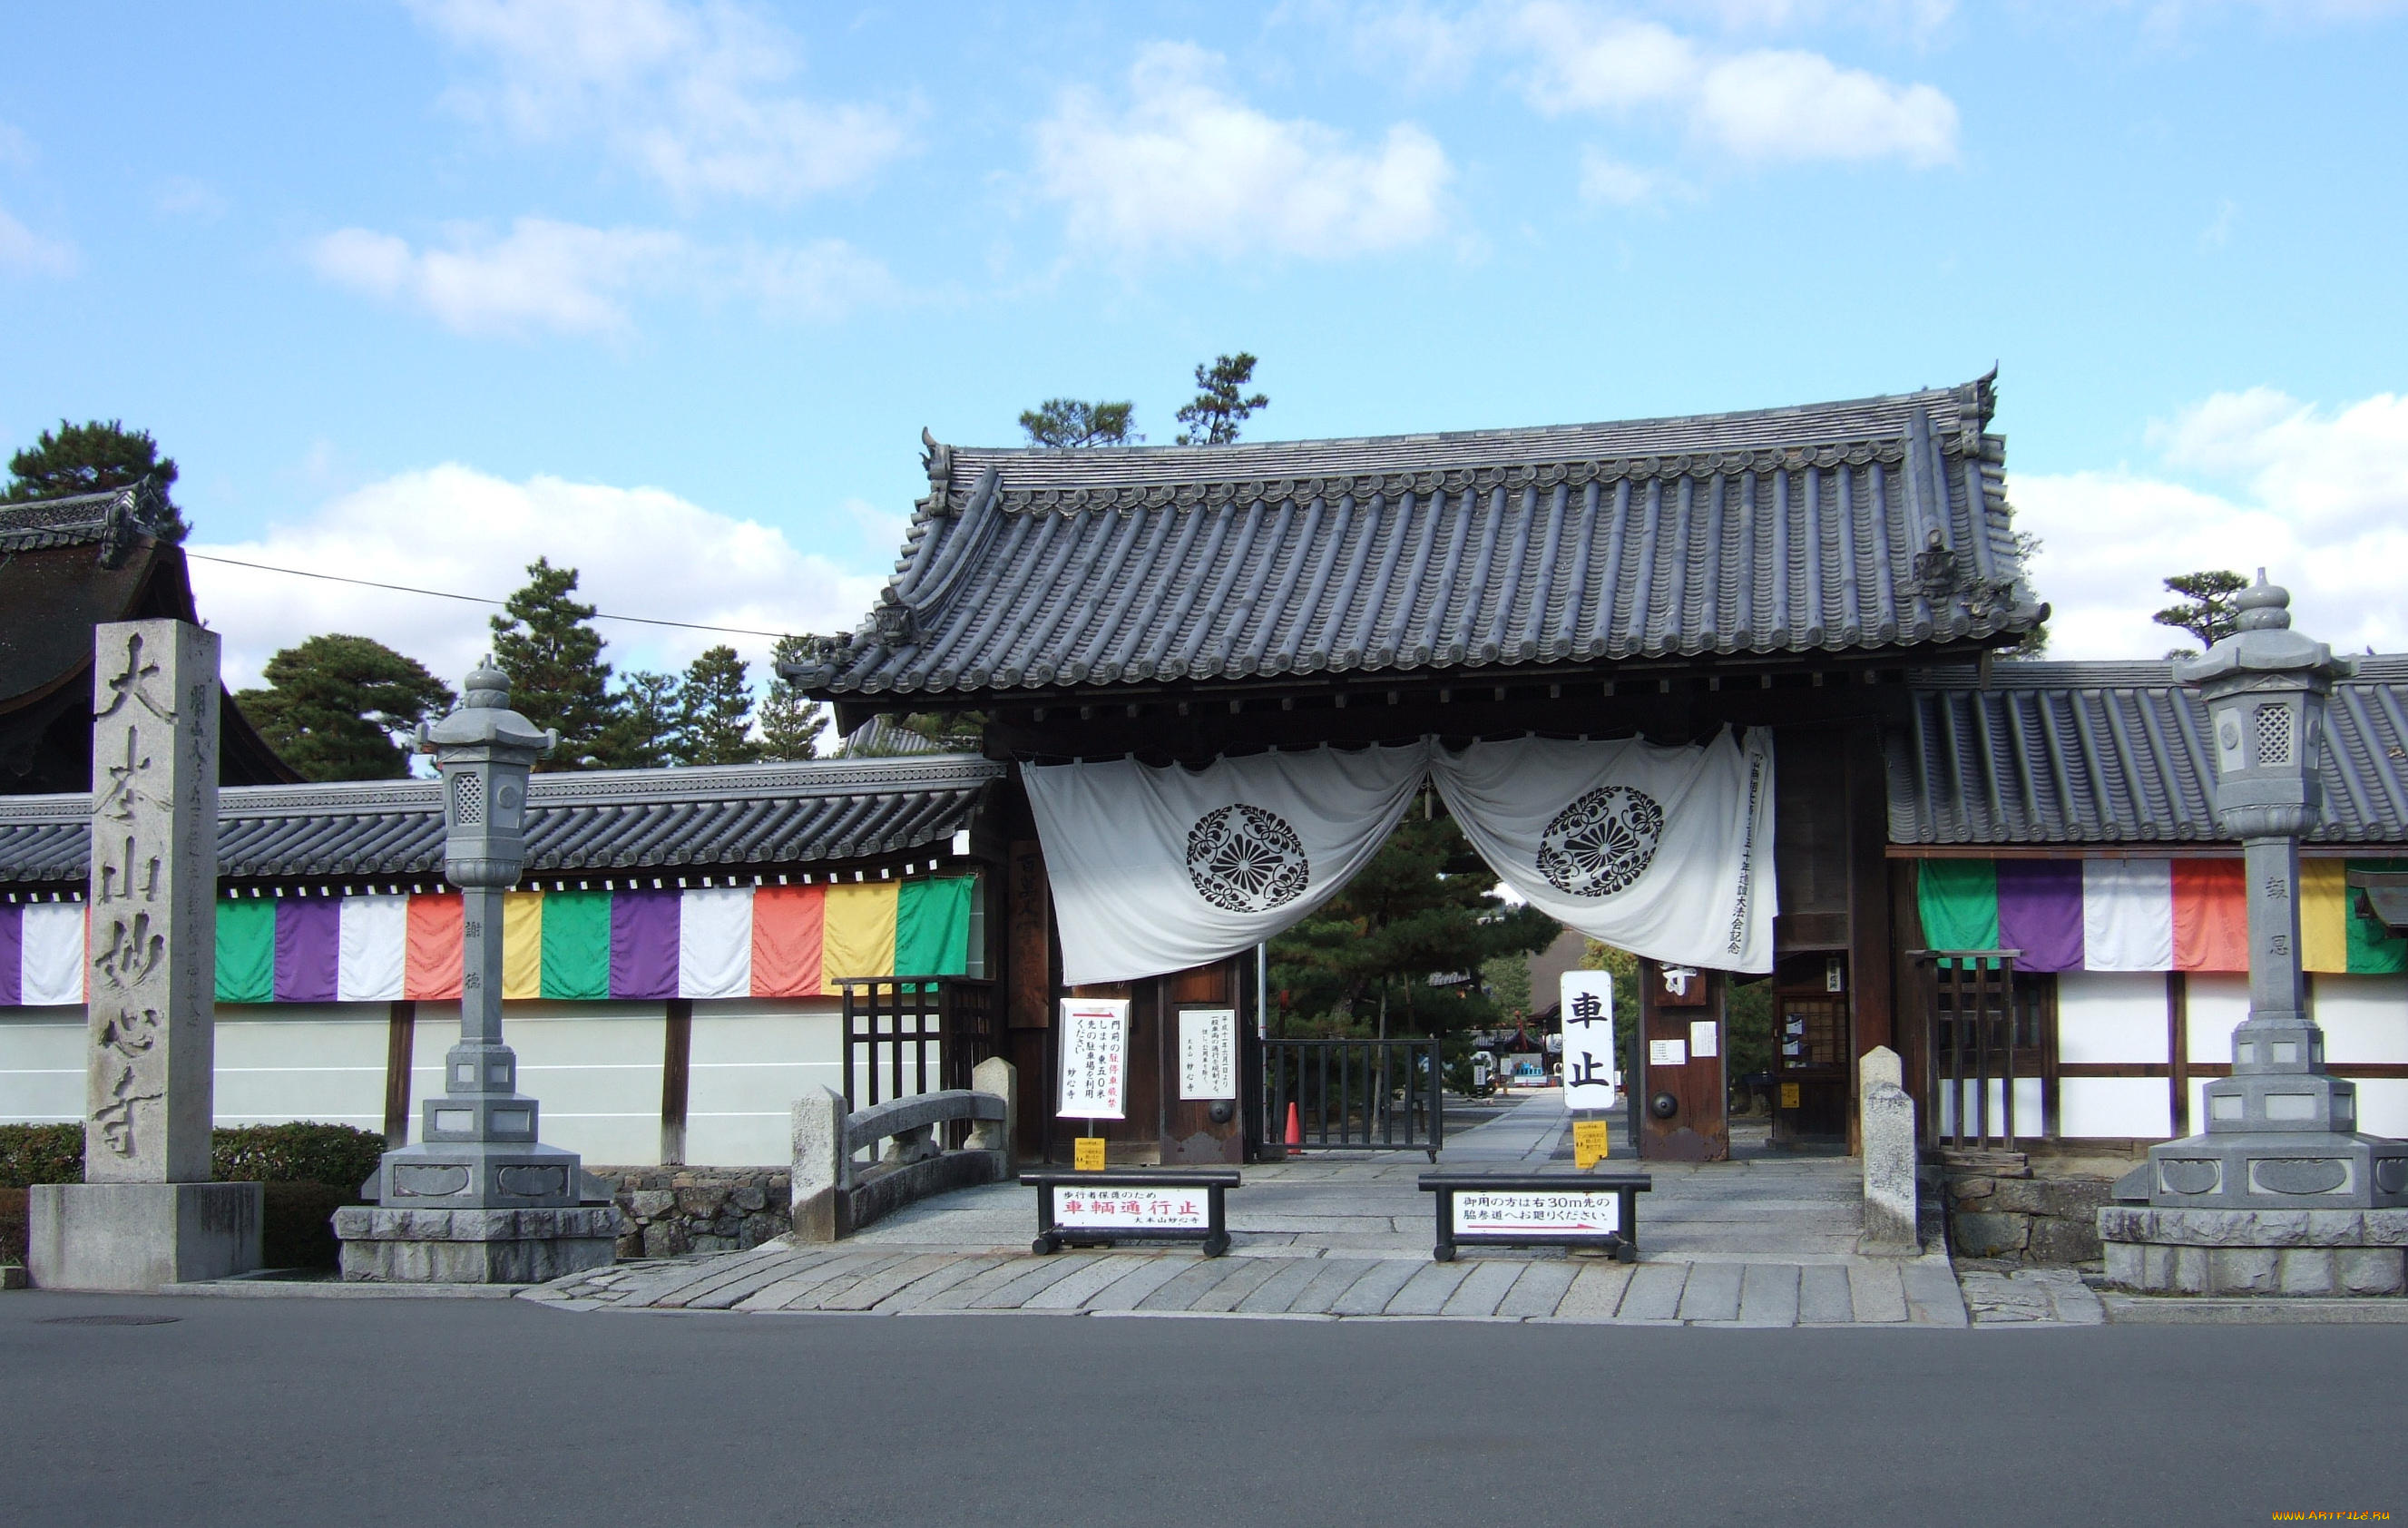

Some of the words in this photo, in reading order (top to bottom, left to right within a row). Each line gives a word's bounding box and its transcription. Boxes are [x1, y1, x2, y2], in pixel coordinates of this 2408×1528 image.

[91, 632, 178, 1159] 大本山妙心寺
[1075, 1019, 1085, 1054] ください
[1566, 991, 1610, 1088] 車止
[1067, 1067, 1076, 1100] 妙心寺
[1463, 1197, 1610, 1208] 御用の方は右30m先の
